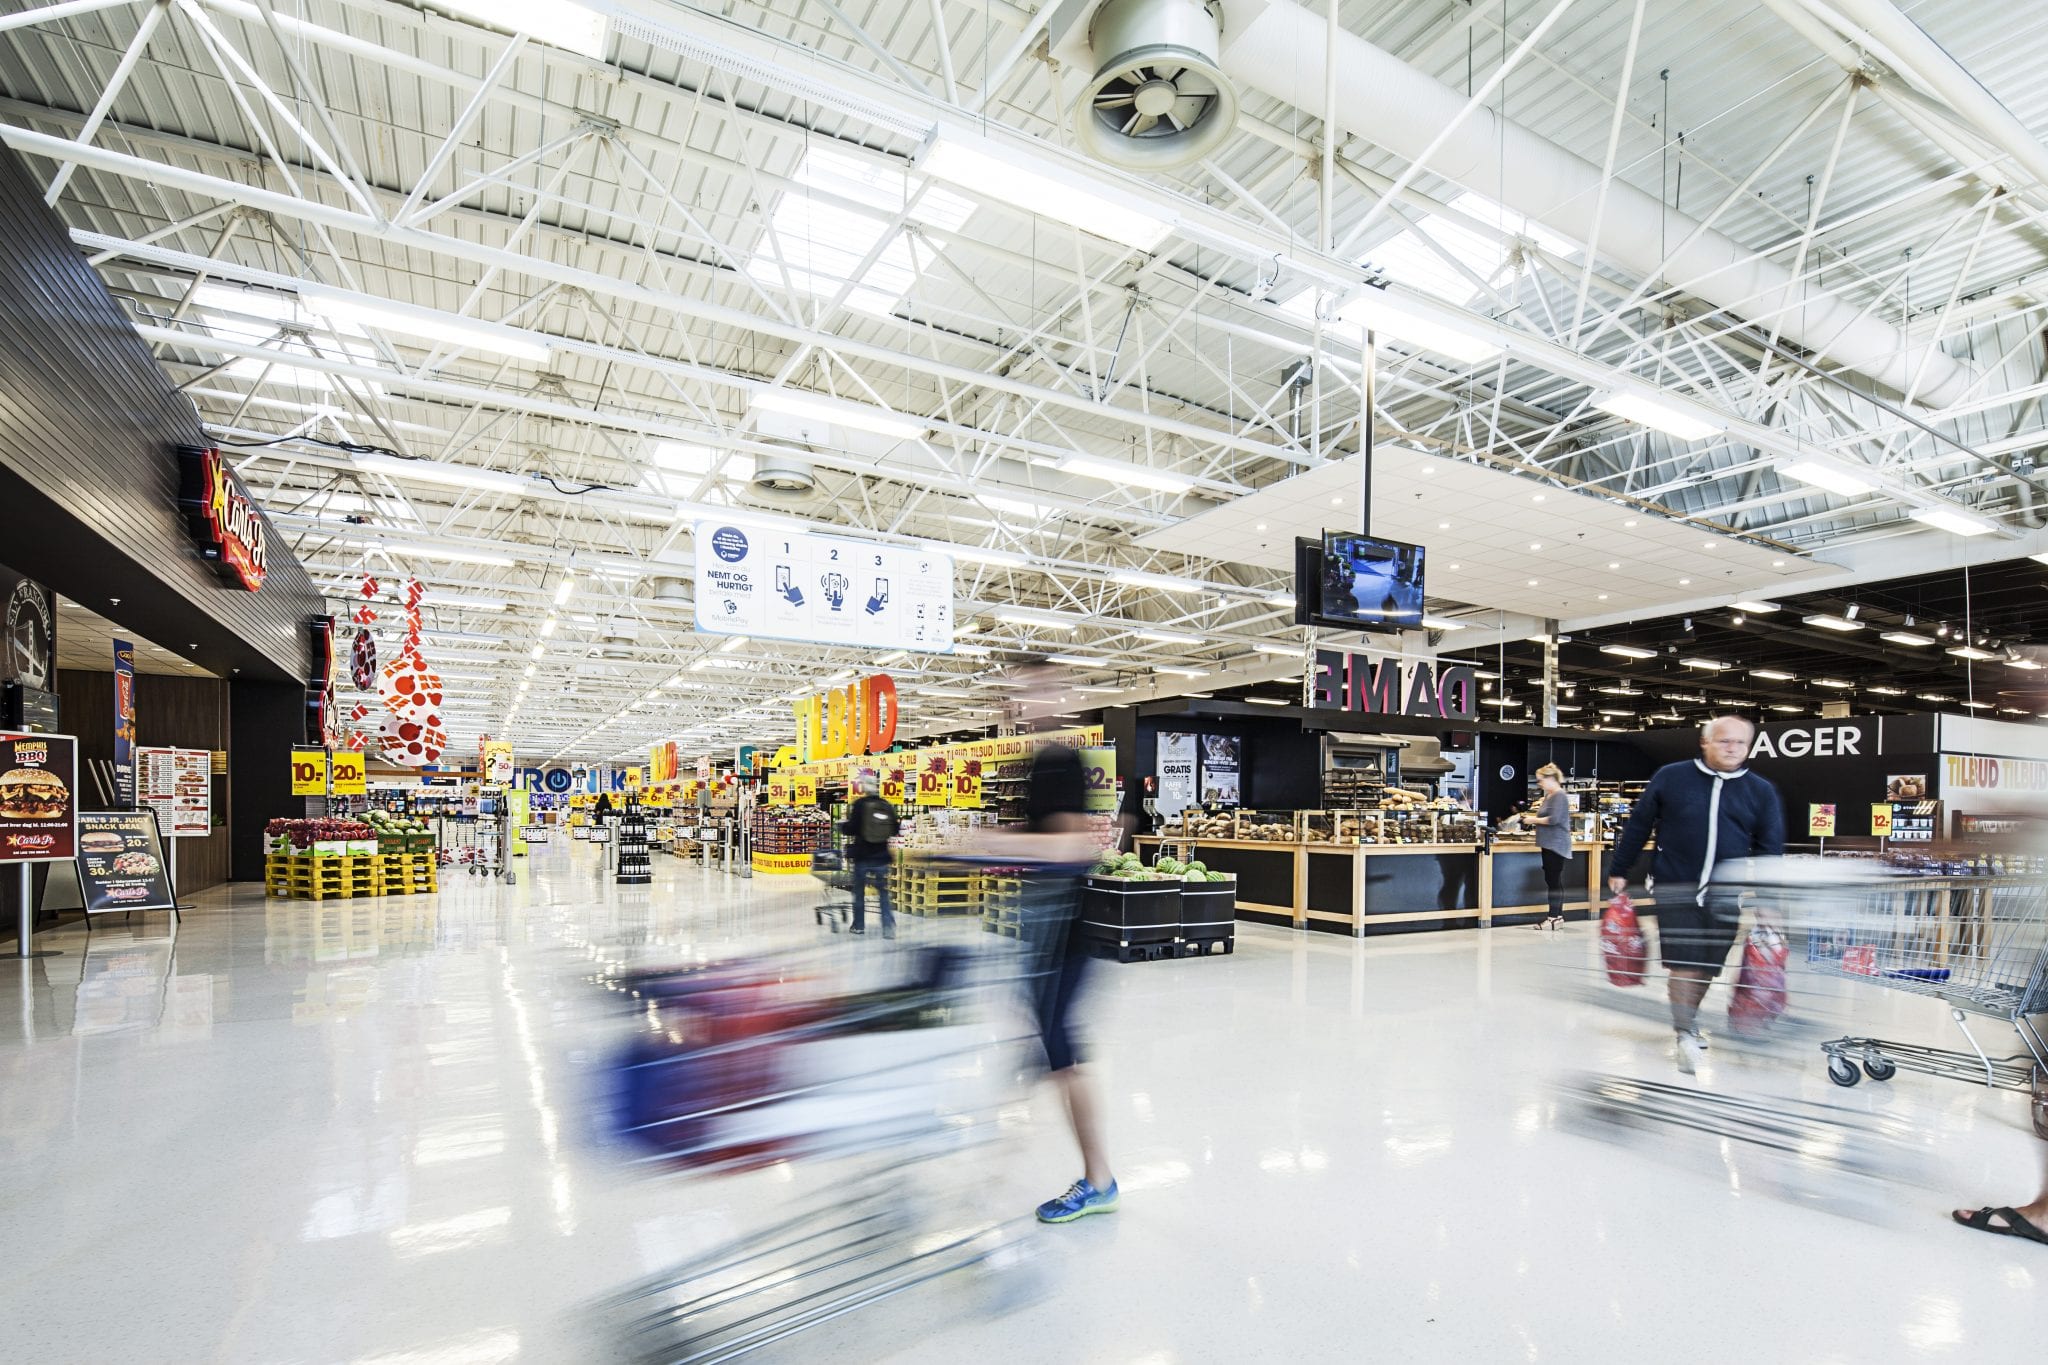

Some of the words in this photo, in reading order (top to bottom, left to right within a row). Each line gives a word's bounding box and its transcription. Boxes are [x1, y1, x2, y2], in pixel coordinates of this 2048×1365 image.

[784, 543, 790, 553] 1
[831, 550, 838, 560] 2
[875, 556, 882, 566] 3
[708, 570, 731, 580] NEMT
[733, 573, 748, 582] OG
[717, 581, 753, 592] HURTIGT
[793, 674, 897, 764] TILBUD
[1005, 729, 1015, 737] 13
[1748, 726, 1861, 758] AGER
[997, 742, 1021, 755] TILBUD
[17, 752, 45, 763] BBQ
[1163, 765, 1192, 775] GRATIS
[1947, 757, 1999, 789] TILBUD
[79, 816, 106, 824] ARL'S
[109, 816, 123, 824] JR.
[125, 816, 149, 824] JUICY
